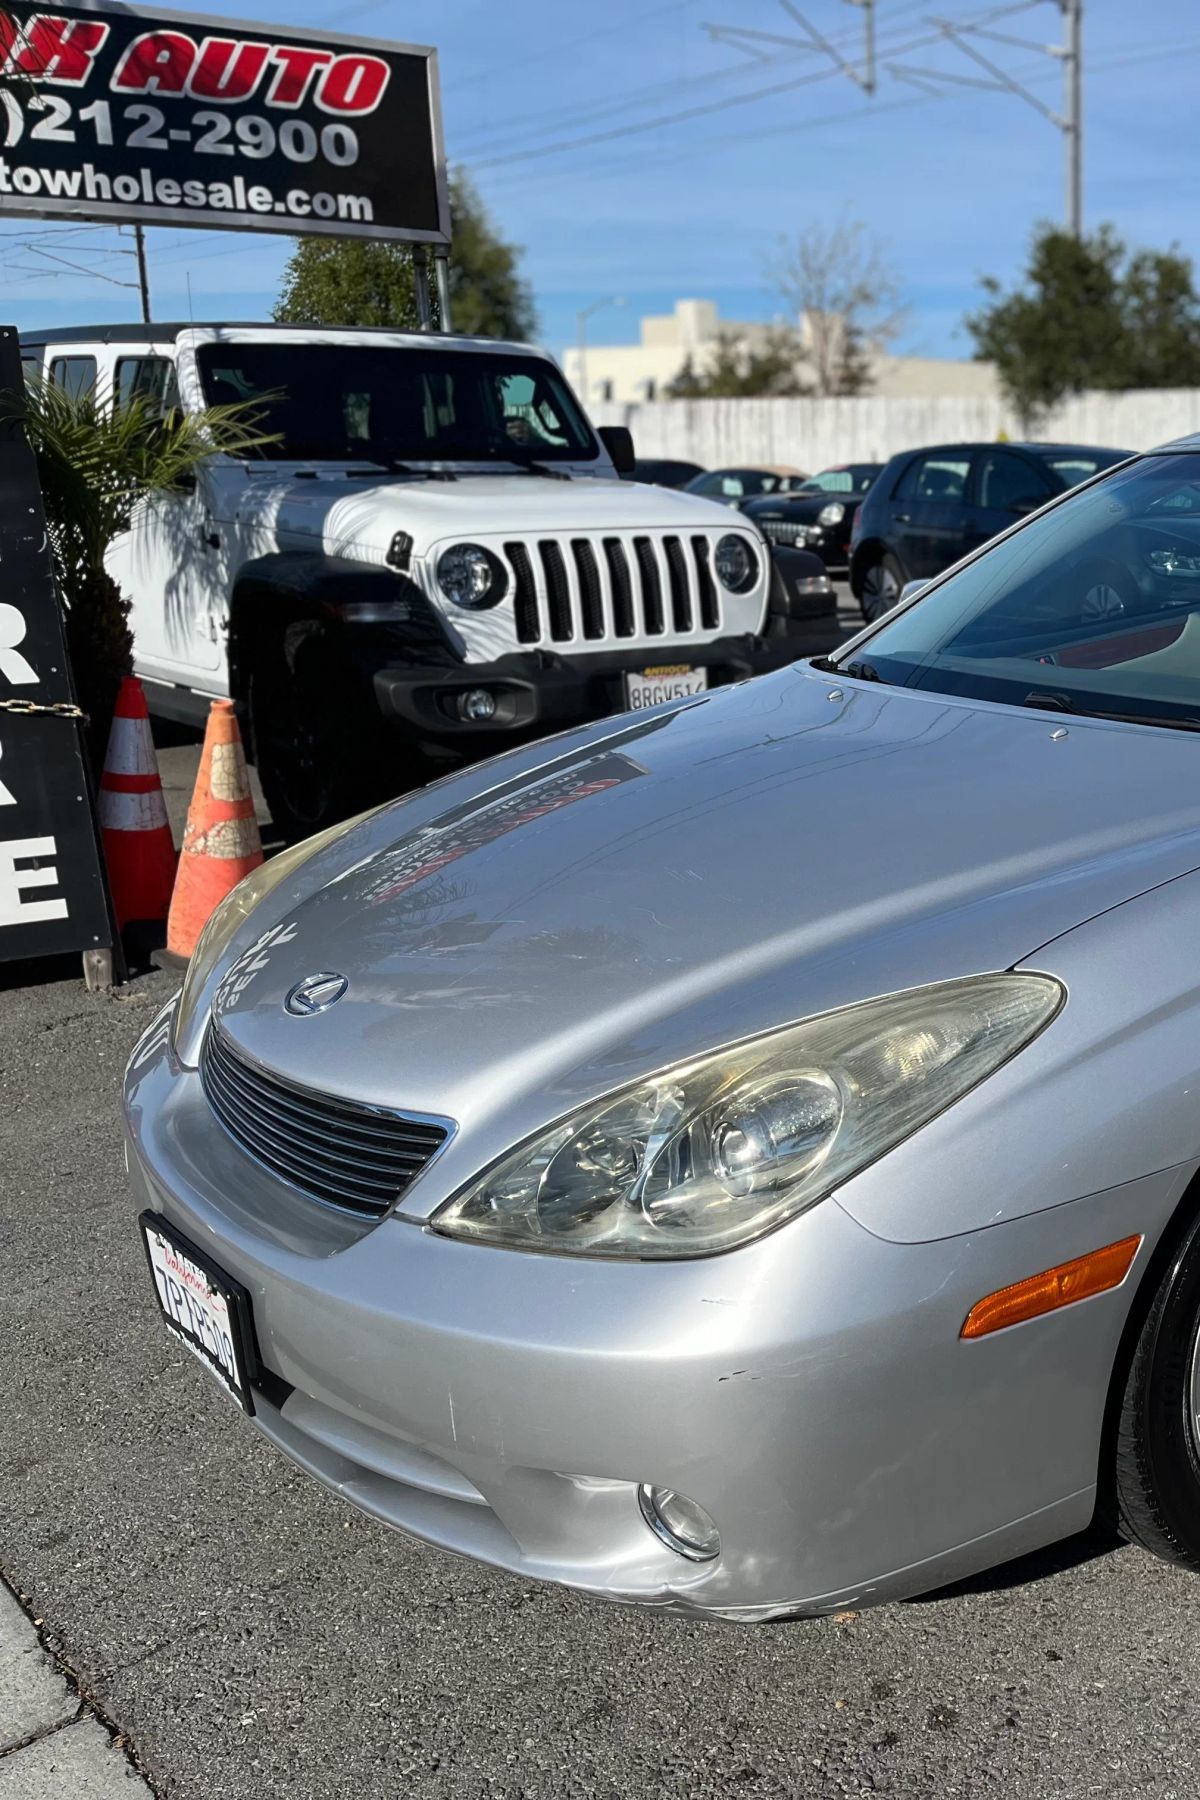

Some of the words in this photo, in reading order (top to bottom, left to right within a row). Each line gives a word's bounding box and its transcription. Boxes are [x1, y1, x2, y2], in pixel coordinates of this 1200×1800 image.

[0, 8, 110, 87] X
[110, 30, 391, 116] AUTO
[644, 664, 691, 677] ANTIOCH
